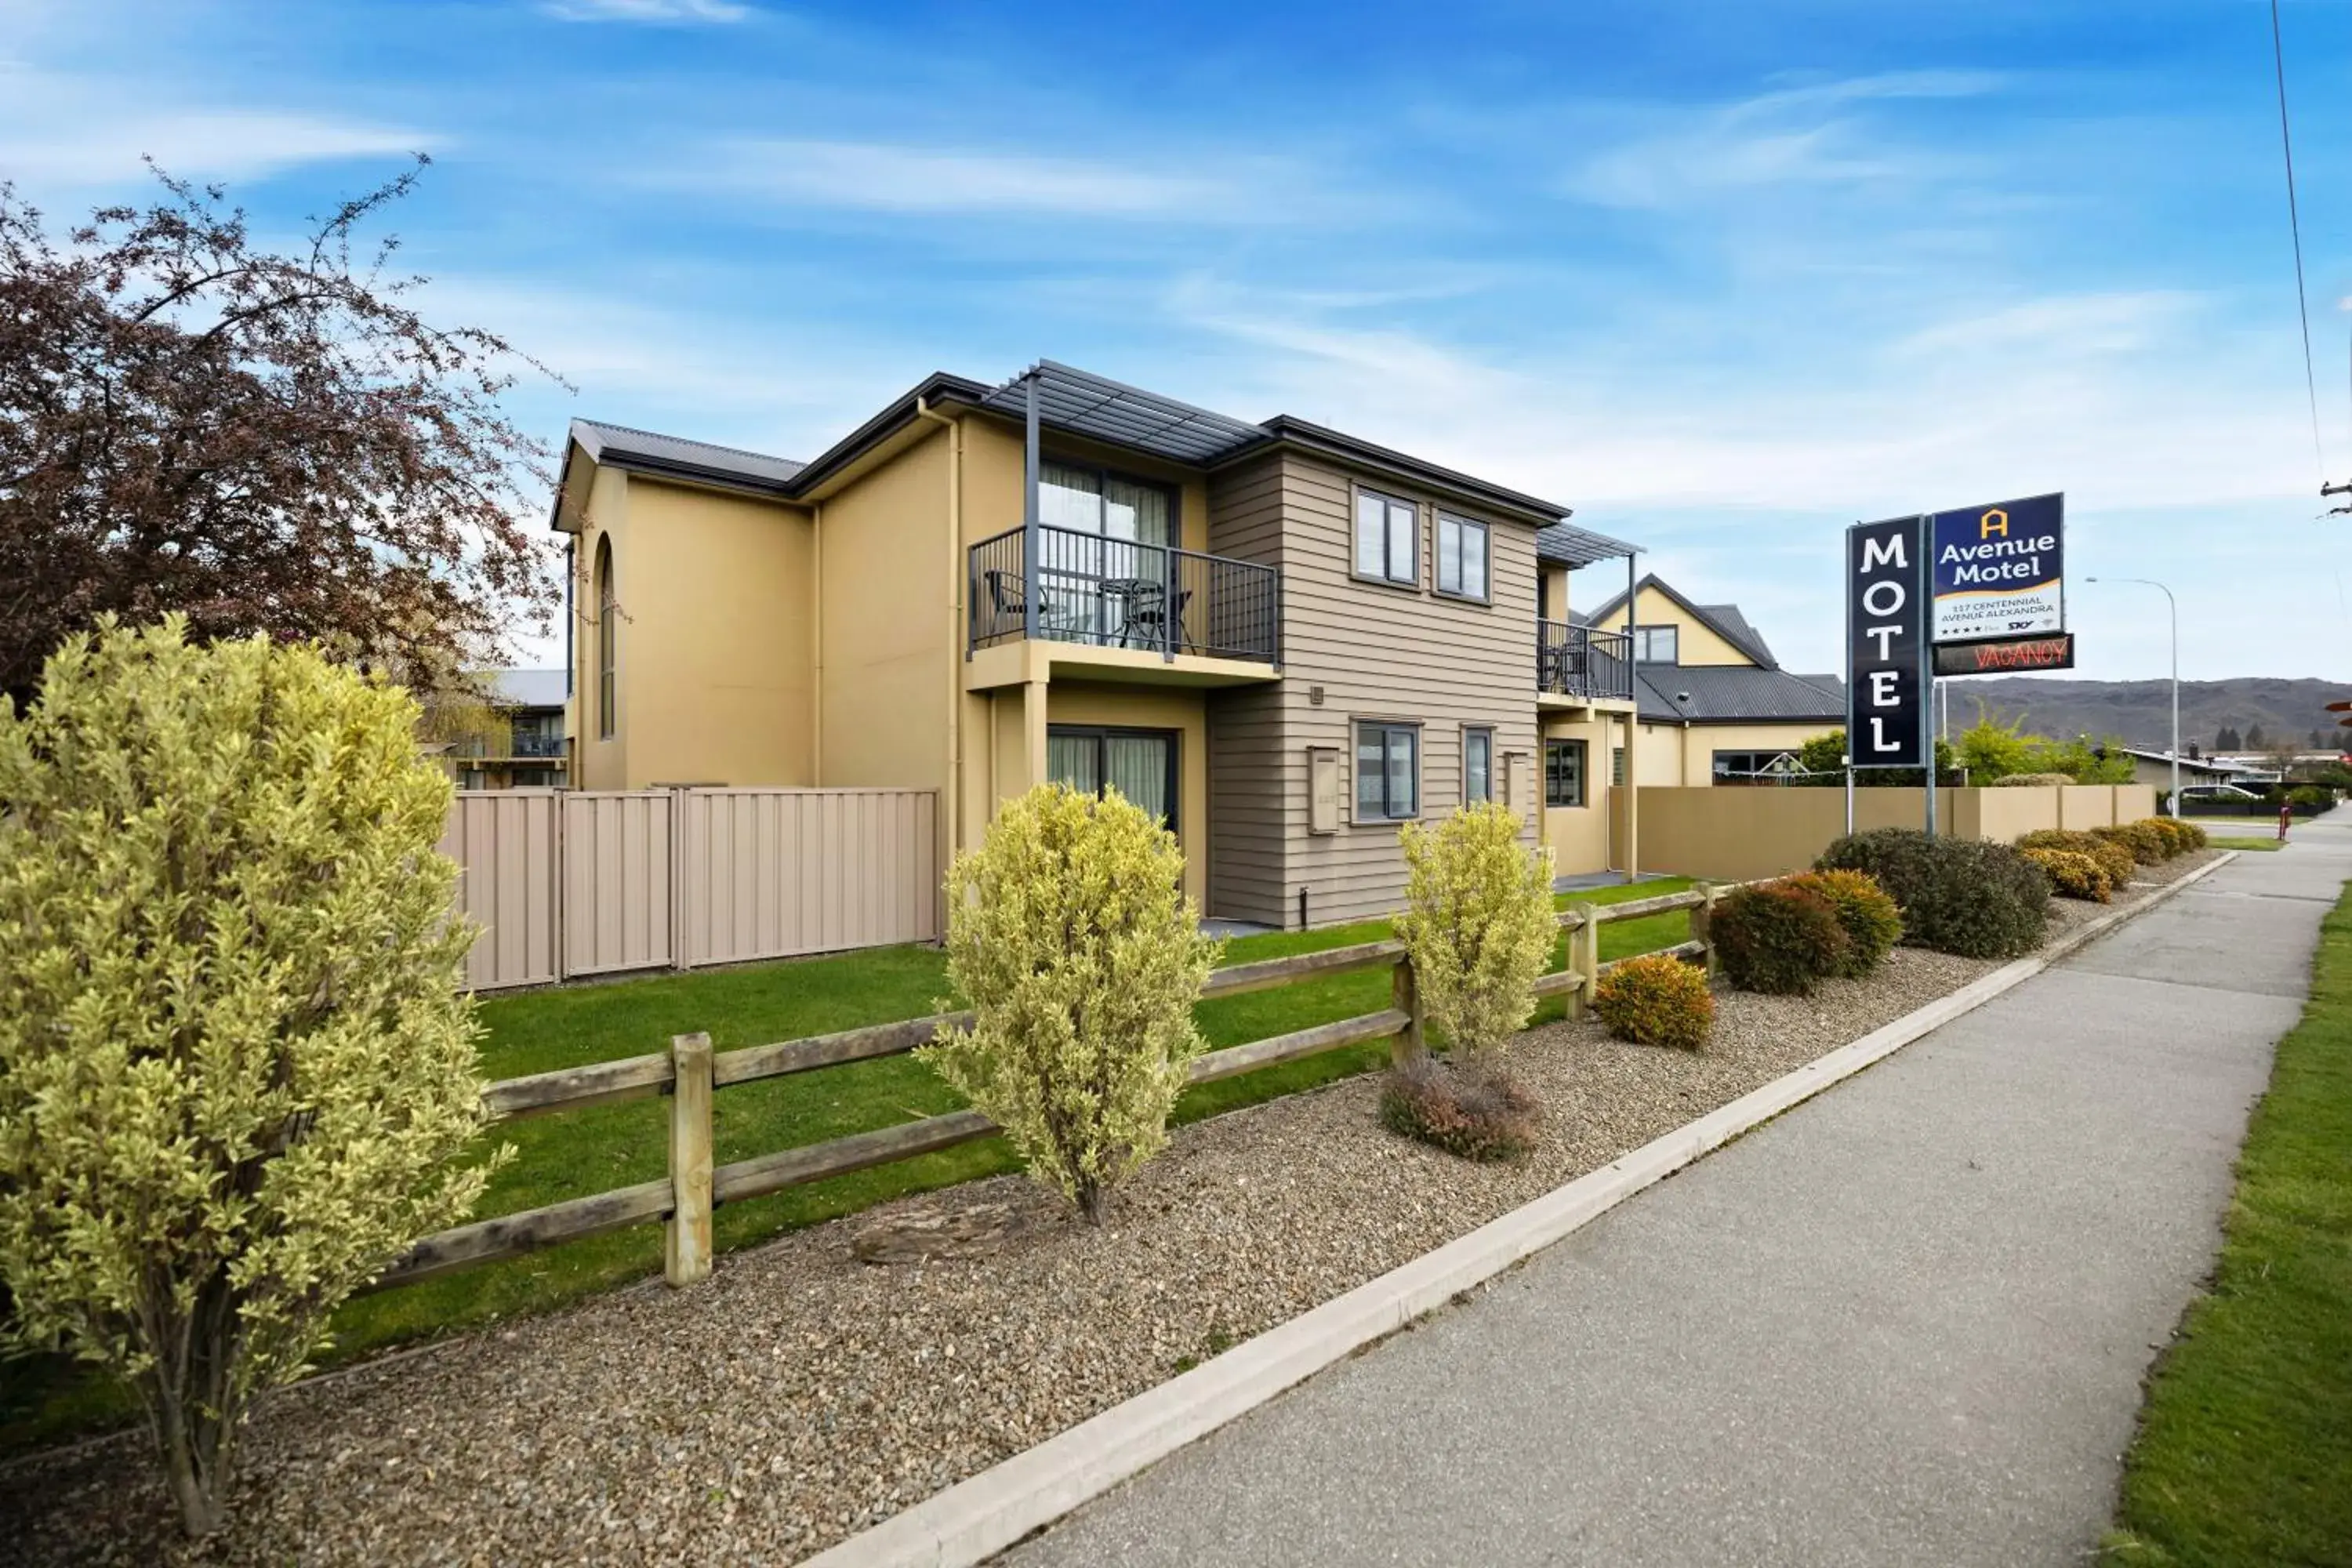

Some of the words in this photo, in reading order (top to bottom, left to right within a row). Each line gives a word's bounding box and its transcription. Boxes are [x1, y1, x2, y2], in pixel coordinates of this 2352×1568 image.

[1939, 535, 2056, 564] Avenue
[1953, 557, 2041, 586] Motel
[1942, 612, 1985, 622] AVENUE
[1986, 604, 2054, 618] ALEXANDRA
[1973, 597, 2042, 611] CENTENNIAL
[1860, 534, 1909, 752] MOTEL
[1975, 637, 2067, 667] VACANCY
